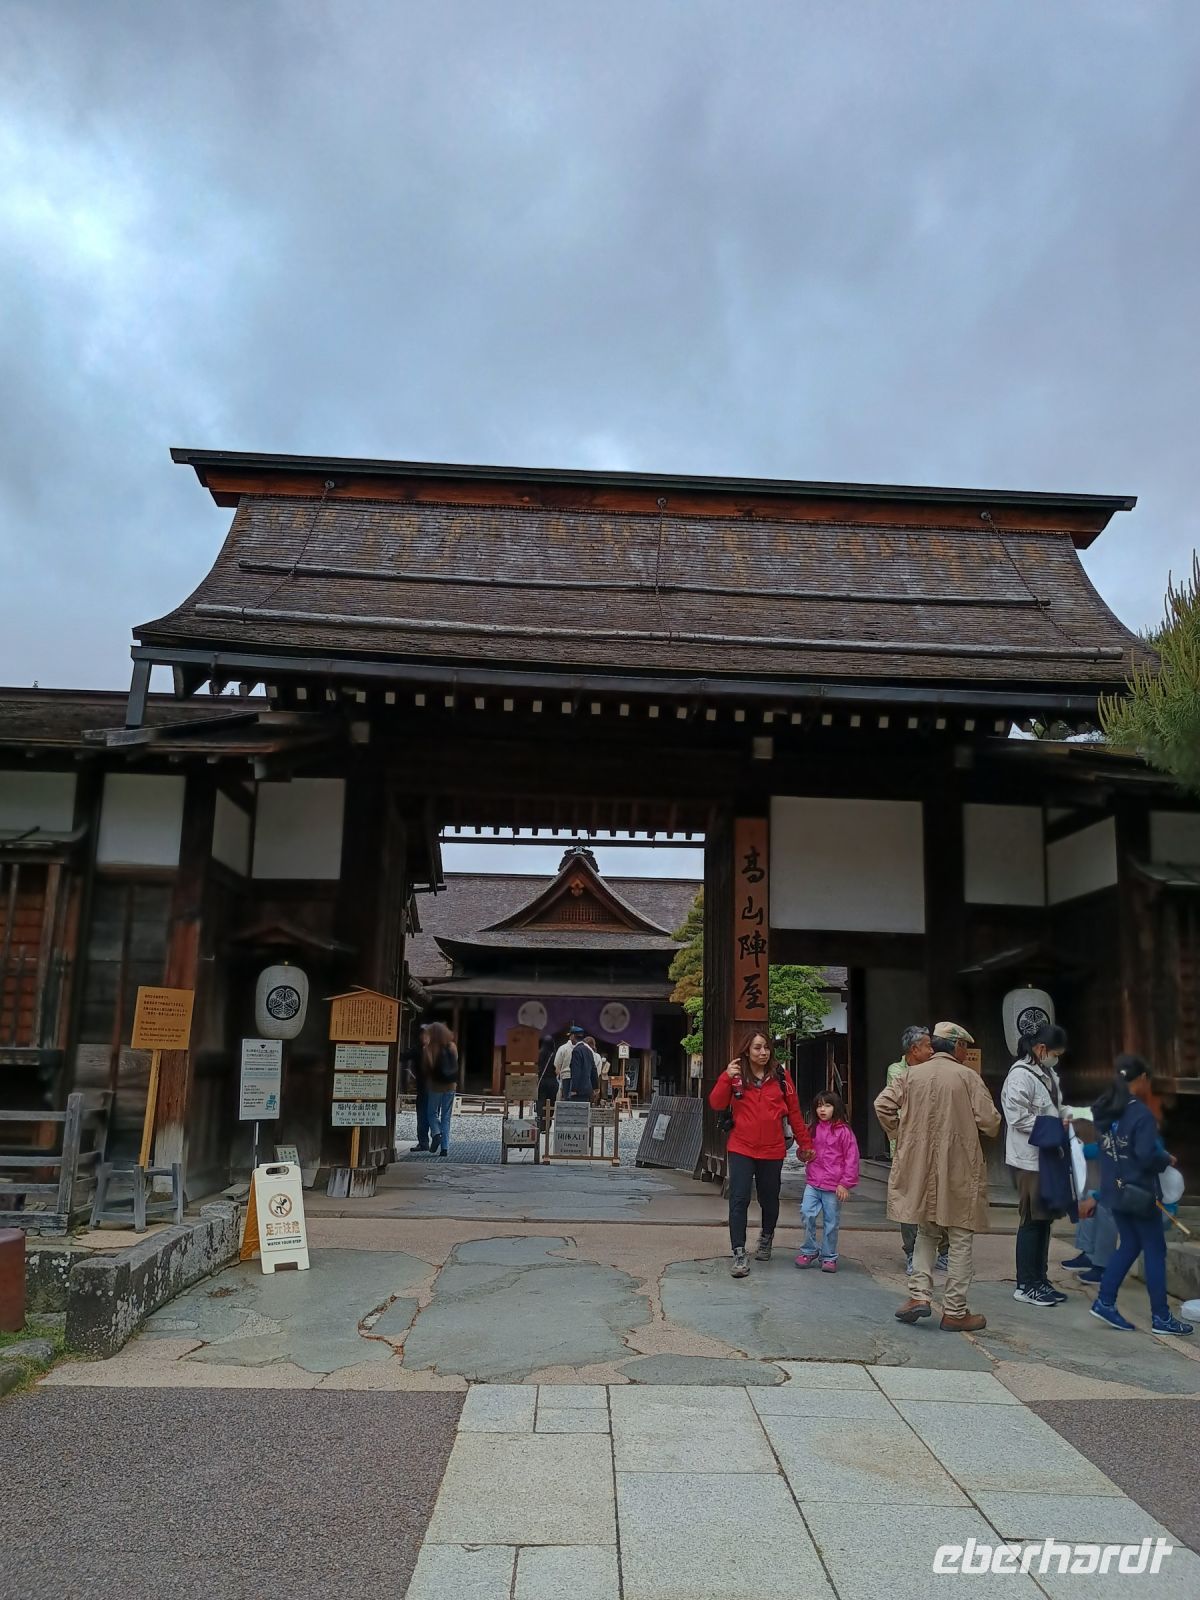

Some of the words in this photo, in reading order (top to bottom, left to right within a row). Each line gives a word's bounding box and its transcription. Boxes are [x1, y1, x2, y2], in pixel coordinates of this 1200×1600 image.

[738, 845, 767, 1010] 高山陣屋
[265, 1220, 301, 1237] 足元注意
